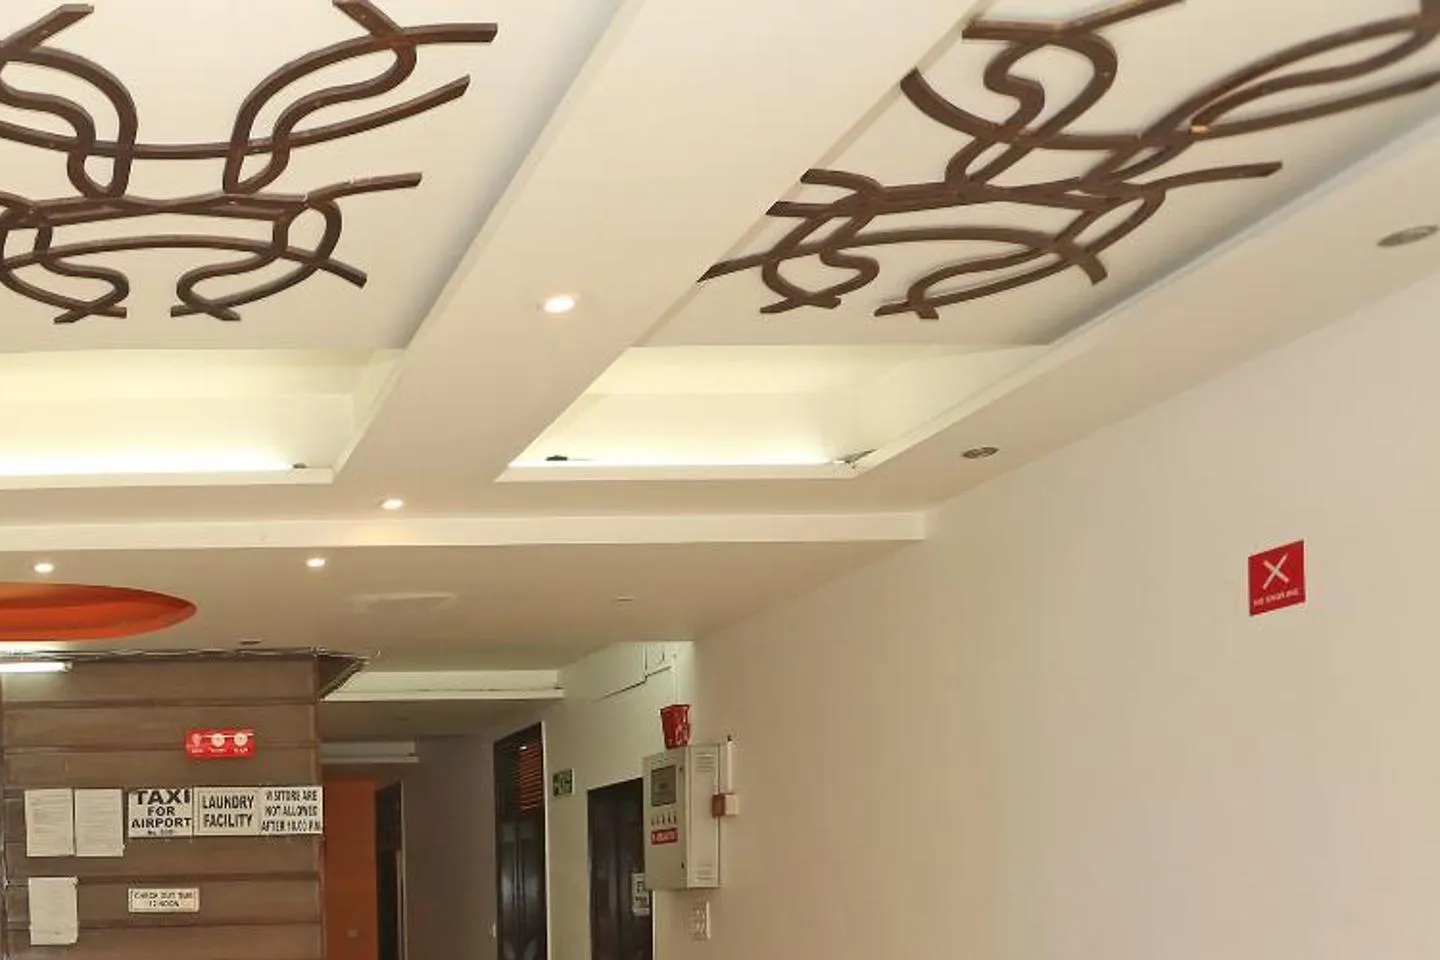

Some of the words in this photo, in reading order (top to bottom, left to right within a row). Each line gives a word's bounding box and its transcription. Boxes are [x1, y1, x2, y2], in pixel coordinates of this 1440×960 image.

[136, 789, 191, 805] TAXI
[302, 789, 318, 801] ARE
[202, 795, 254, 809] LAUNDRY
[147, 806, 176, 816] FOR
[265, 805, 281, 816] NOT
[131, 817, 192, 829] AIRPORT
[203, 813, 253, 828] FACILITY
[262, 820, 285, 832] AFTER
